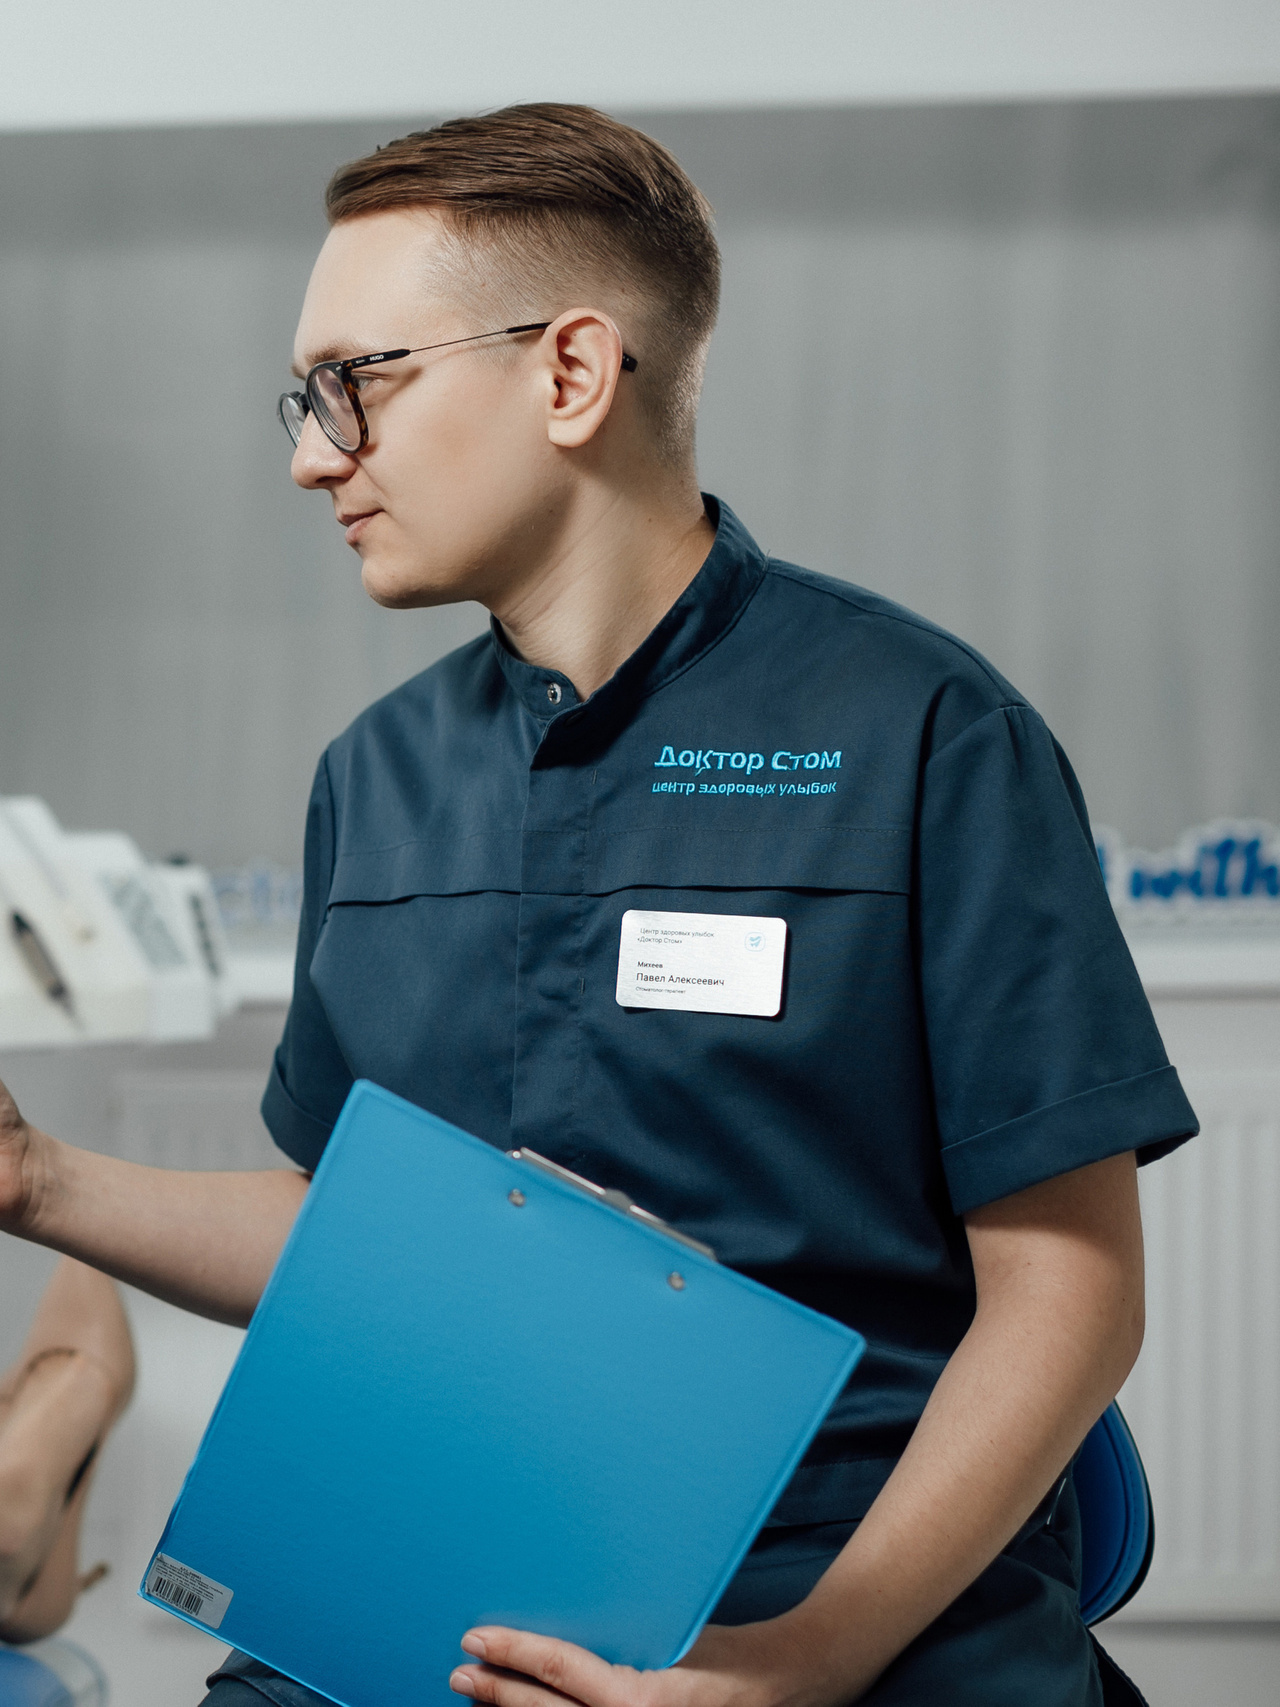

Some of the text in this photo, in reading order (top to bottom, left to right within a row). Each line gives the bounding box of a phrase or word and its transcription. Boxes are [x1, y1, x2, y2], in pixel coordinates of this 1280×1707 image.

[369, 354, 384, 362] HUGO
[654, 745, 842, 776] Доктор Стом
[652, 781, 837, 797] центр здоровых улыбок
[640, 927, 715, 938] Центр здоровых улыбок
[637, 961, 663, 969] Михеев
[636, 972, 725, 986] Павел Алексеевич
